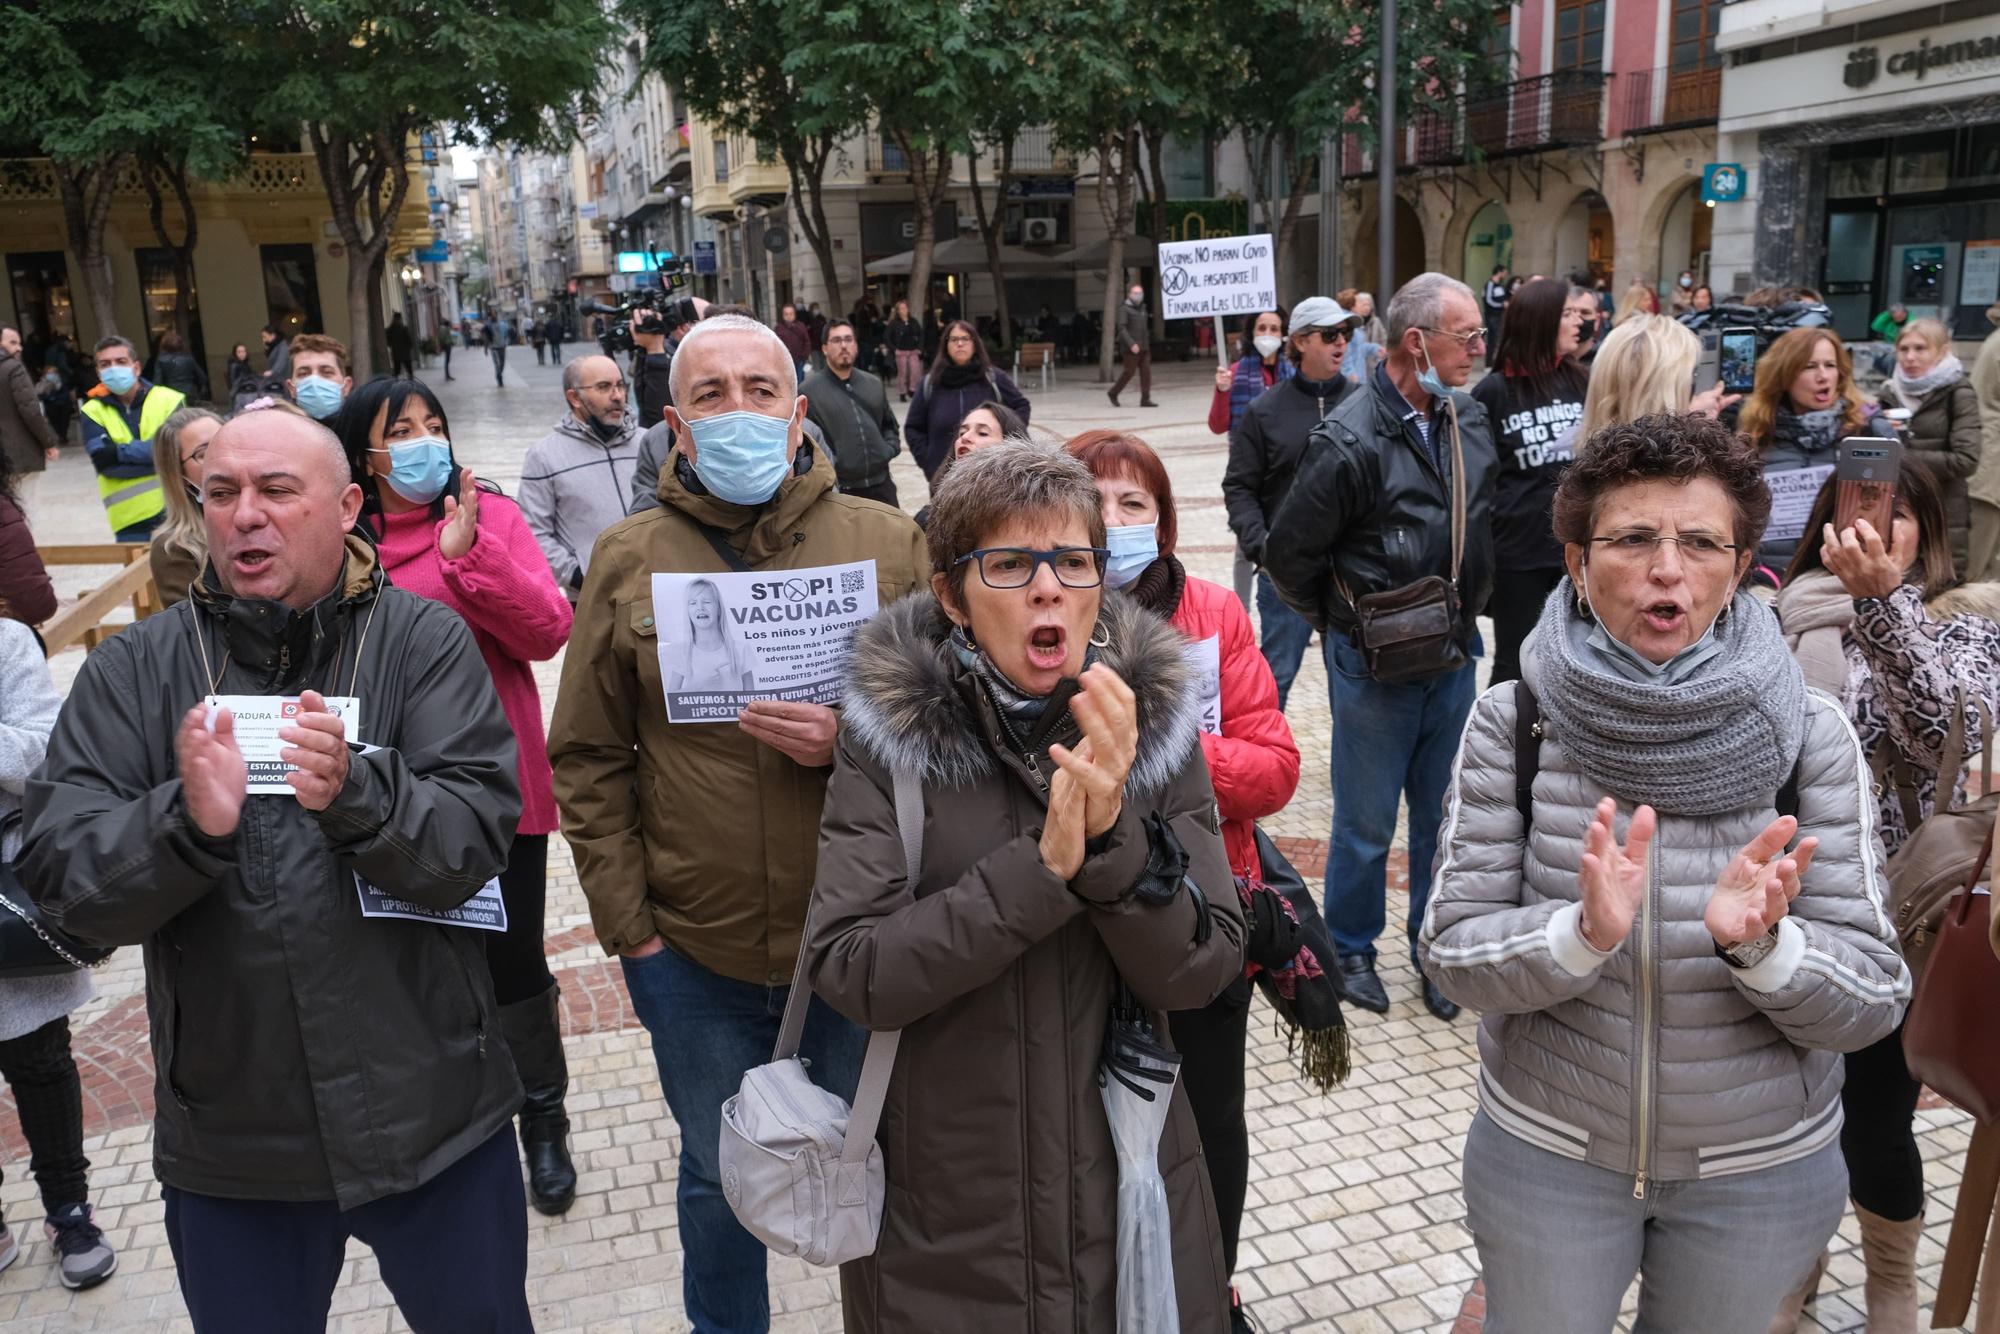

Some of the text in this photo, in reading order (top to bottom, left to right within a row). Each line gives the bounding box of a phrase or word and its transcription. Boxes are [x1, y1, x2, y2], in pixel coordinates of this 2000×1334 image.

[1195, 246, 1210, 263] NO
[1212, 248, 1239, 261] PARAN
[1189, 275, 1201, 287] AL
[1167, 298, 1210, 314] FINANCIA
[1501, 399, 1583, 435] LOS NIÑOS
[1521, 424, 1549, 445] NO
[730, 596, 858, 625] VACUNAS
[744, 630, 768, 640] Los
[771, 626, 806, 639] niños
[810, 626, 817, 637] y
[756, 643, 801, 653] Presentan
[803, 640, 822, 650] más
[765, 653, 804, 663] adversas
[814, 649, 827, 657] las
[805, 656, 841, 668] especial
[759, 671, 812, 683] MIOCARDITIS
[678, 695, 725, 705] SALVEMOS
[728, 695, 735, 703] A
[737, 693, 778, 704] NUESTRA
[780, 688, 816, 701] FUTURA
[233, 712, 272, 720] TADURA
[250, 763, 270, 771] ESTA
[271, 763, 282, 771] LA
[283, 763, 301, 771] LIBE
[248, 774, 288, 782] DEMOCRA
